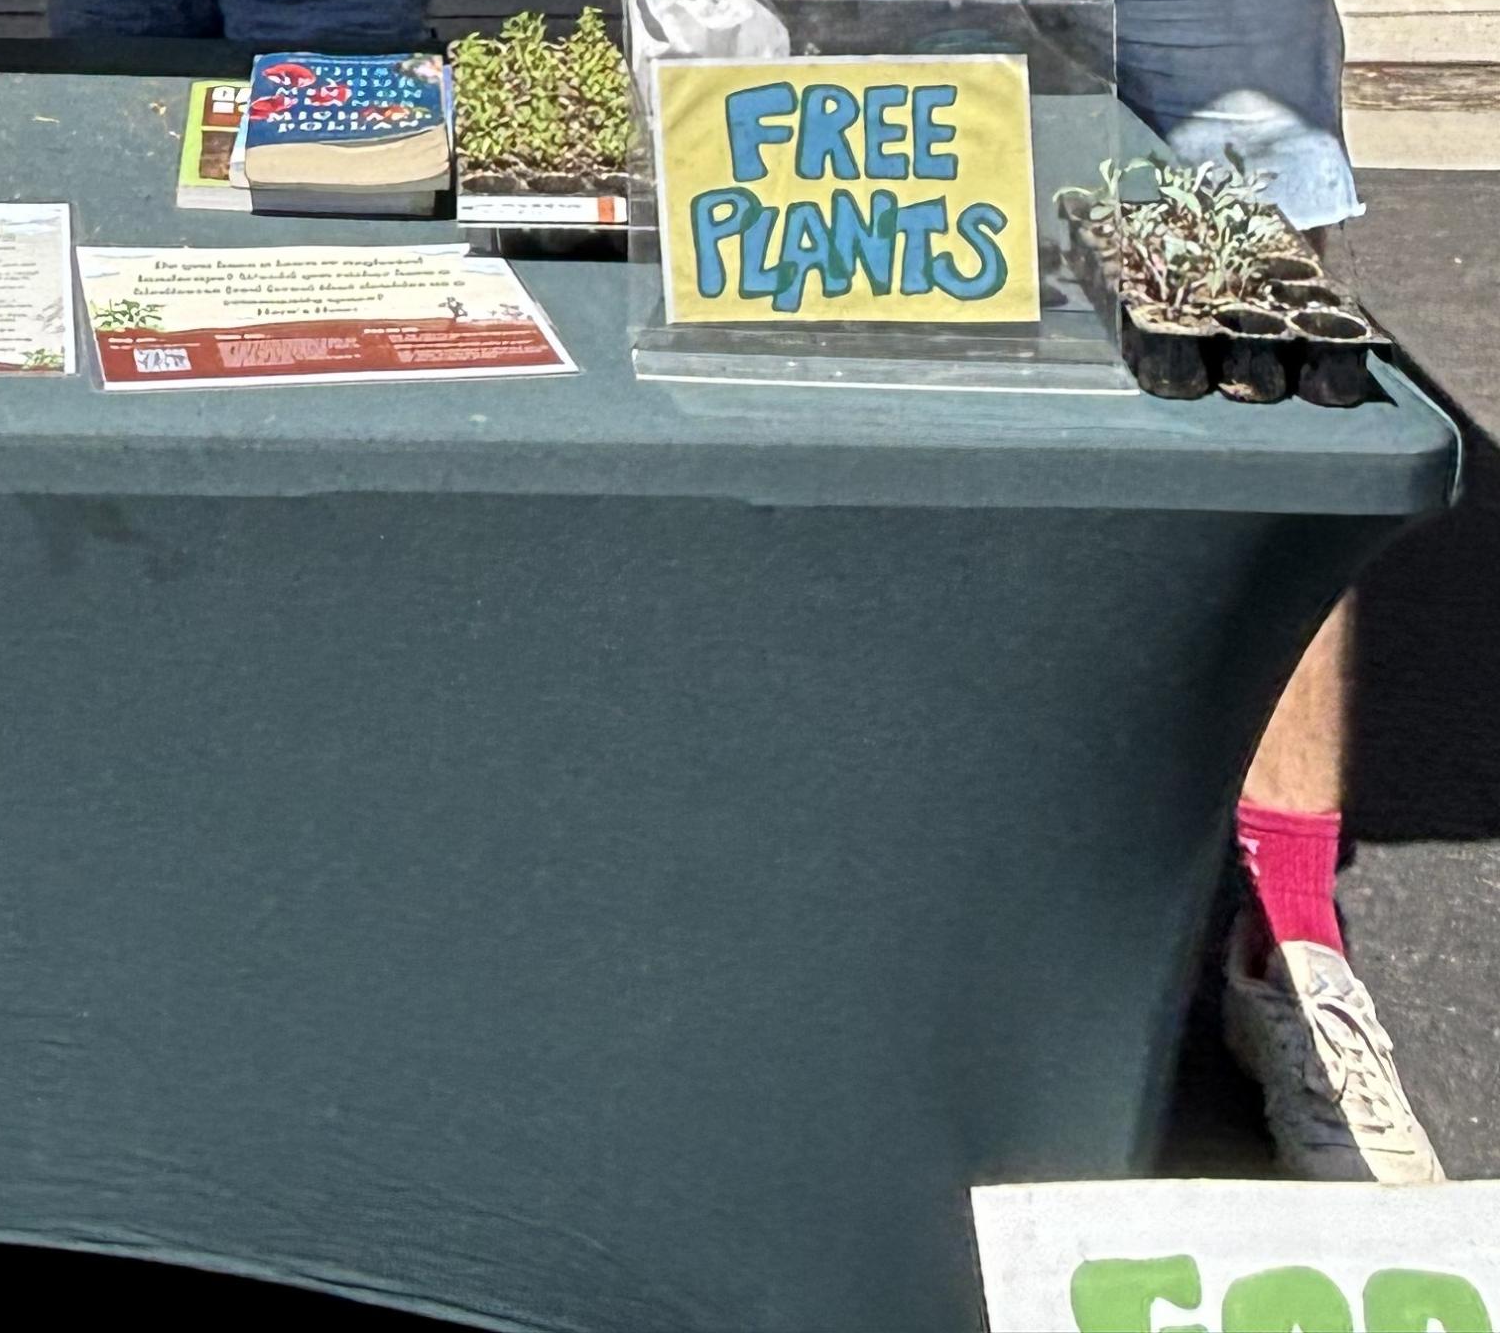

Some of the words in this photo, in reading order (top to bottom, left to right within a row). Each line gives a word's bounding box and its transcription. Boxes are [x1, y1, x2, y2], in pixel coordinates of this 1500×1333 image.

[277, 118, 421, 134] POLLAN
[725, 81, 959, 183] FREE
[690, 186, 1009, 314] PLANTS
